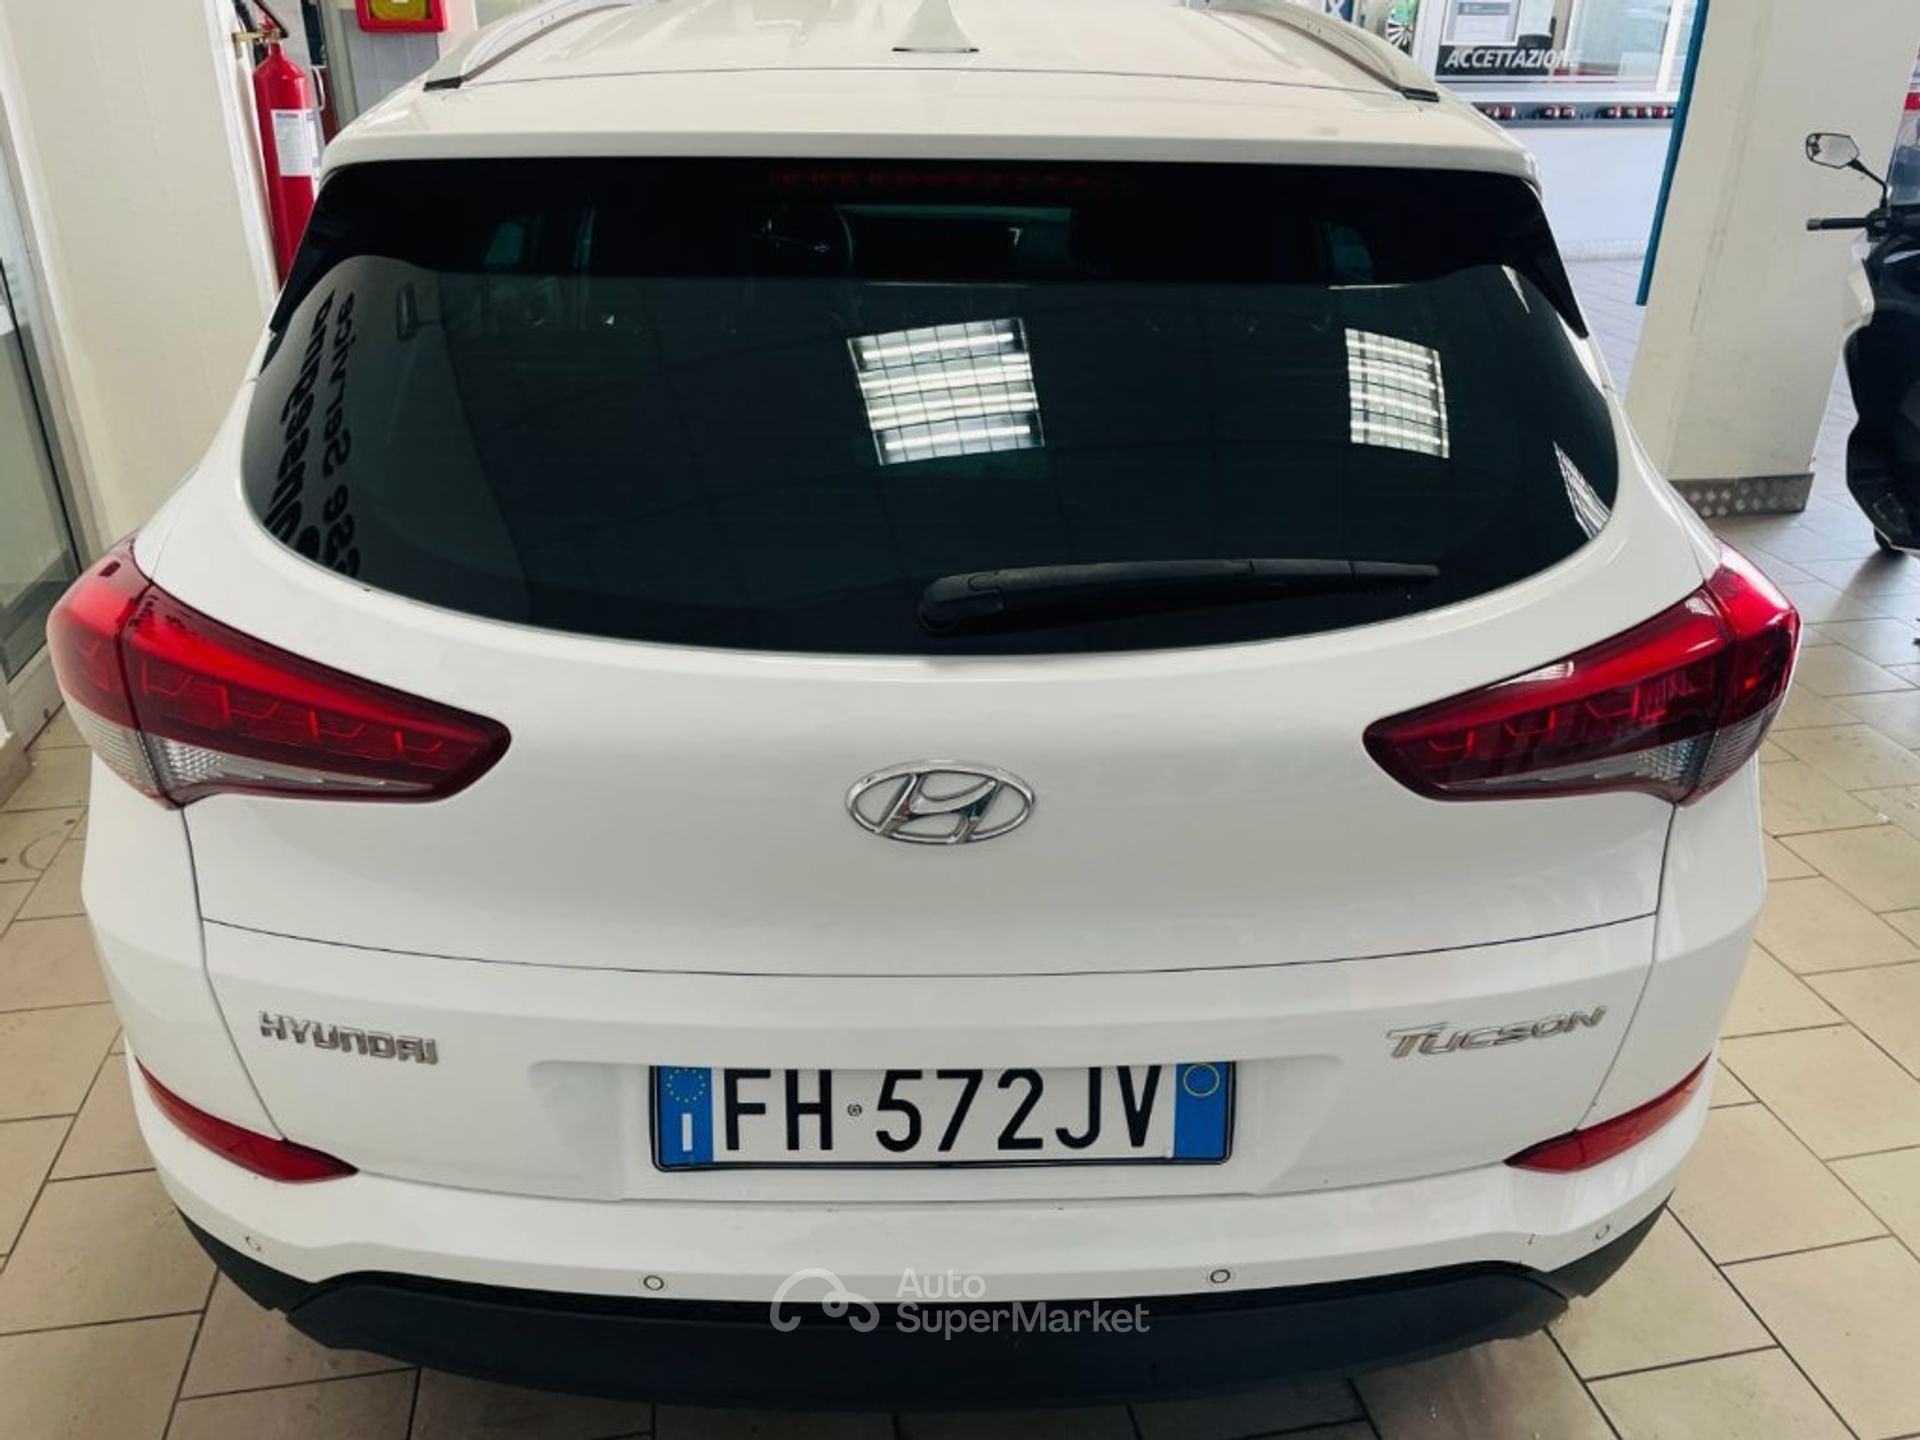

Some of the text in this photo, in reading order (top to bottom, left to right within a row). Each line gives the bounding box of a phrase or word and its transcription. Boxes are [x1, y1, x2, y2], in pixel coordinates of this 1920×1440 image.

[259, 1011, 438, 1065] HYUNDAI
[724, 1065, 1163, 1152] FH 572JV
